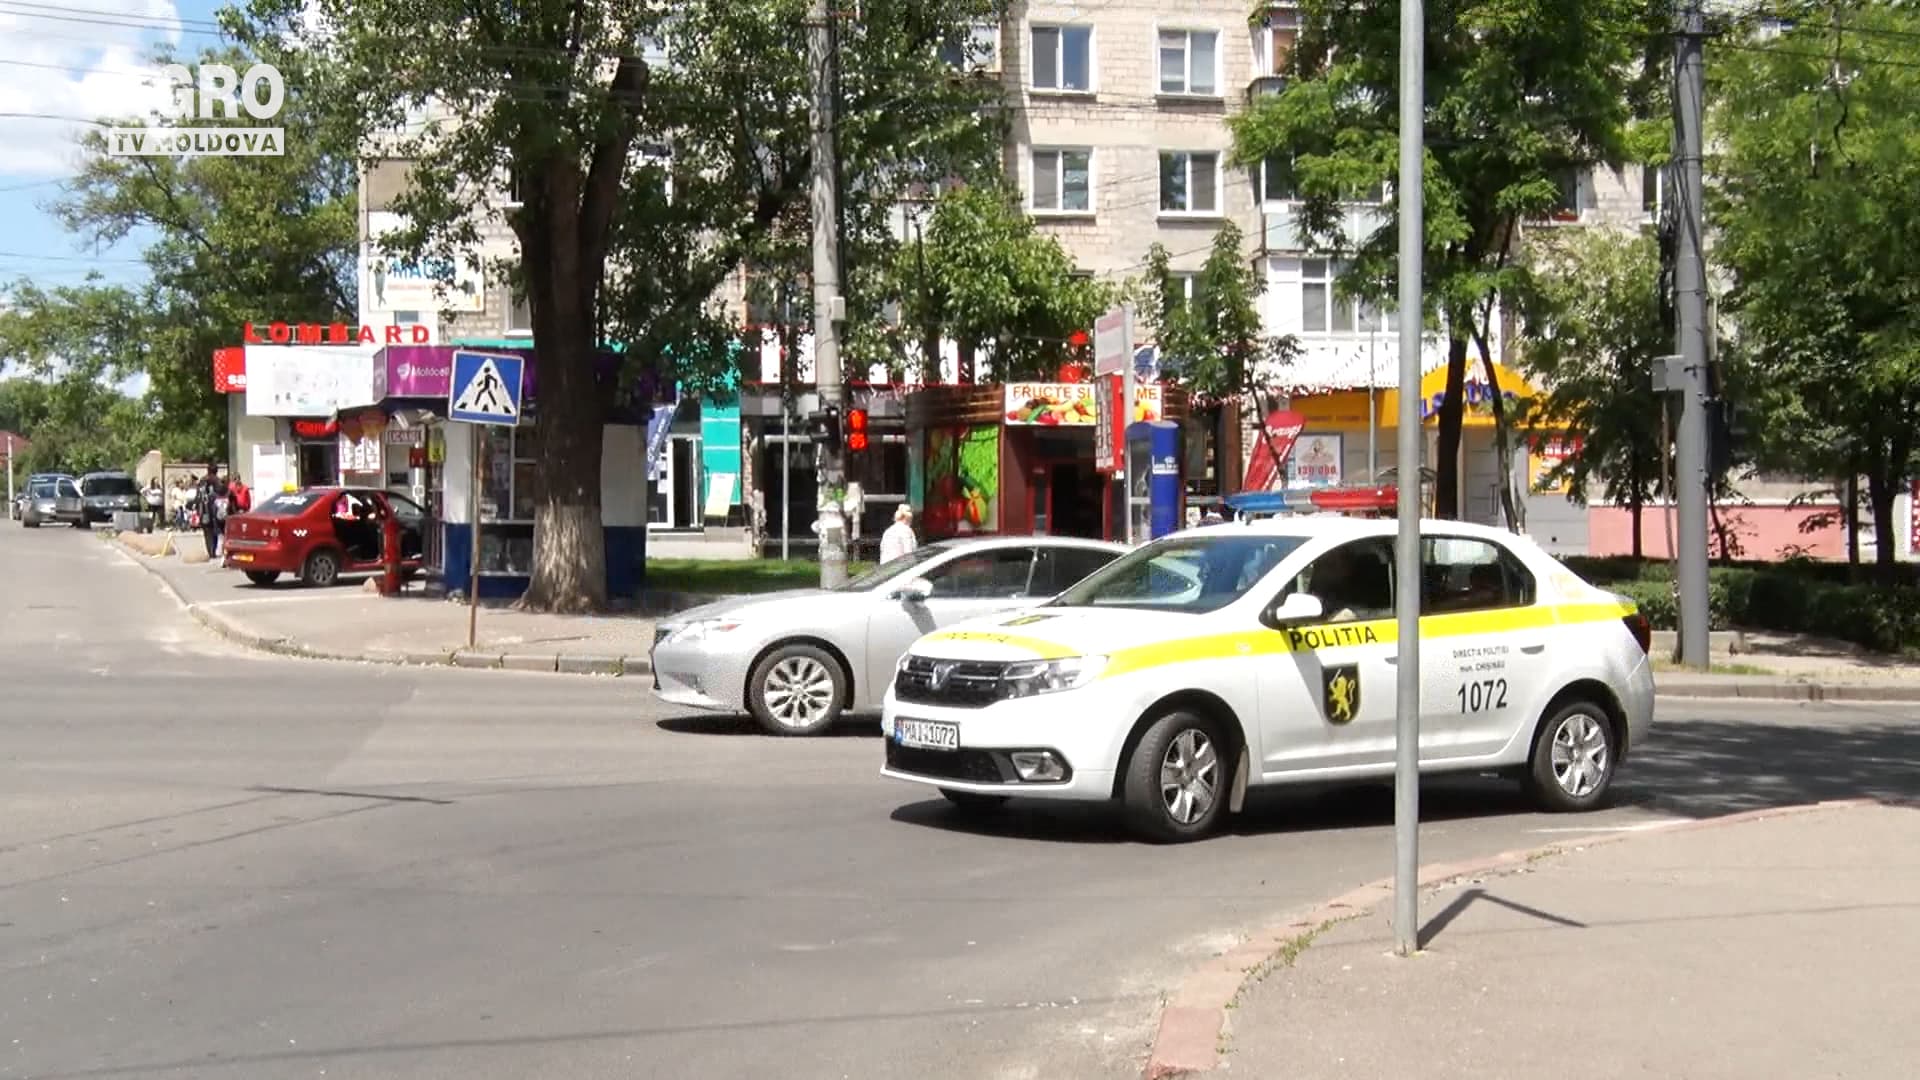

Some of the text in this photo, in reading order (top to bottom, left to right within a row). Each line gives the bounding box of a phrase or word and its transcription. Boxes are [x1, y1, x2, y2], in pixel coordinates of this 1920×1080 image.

[244, 322, 430, 344] LOMBARD
[1013, 385, 1073, 399] FRUCTE
[1457, 678, 1507, 714] 1072
[929, 723, 956, 746] 1072
